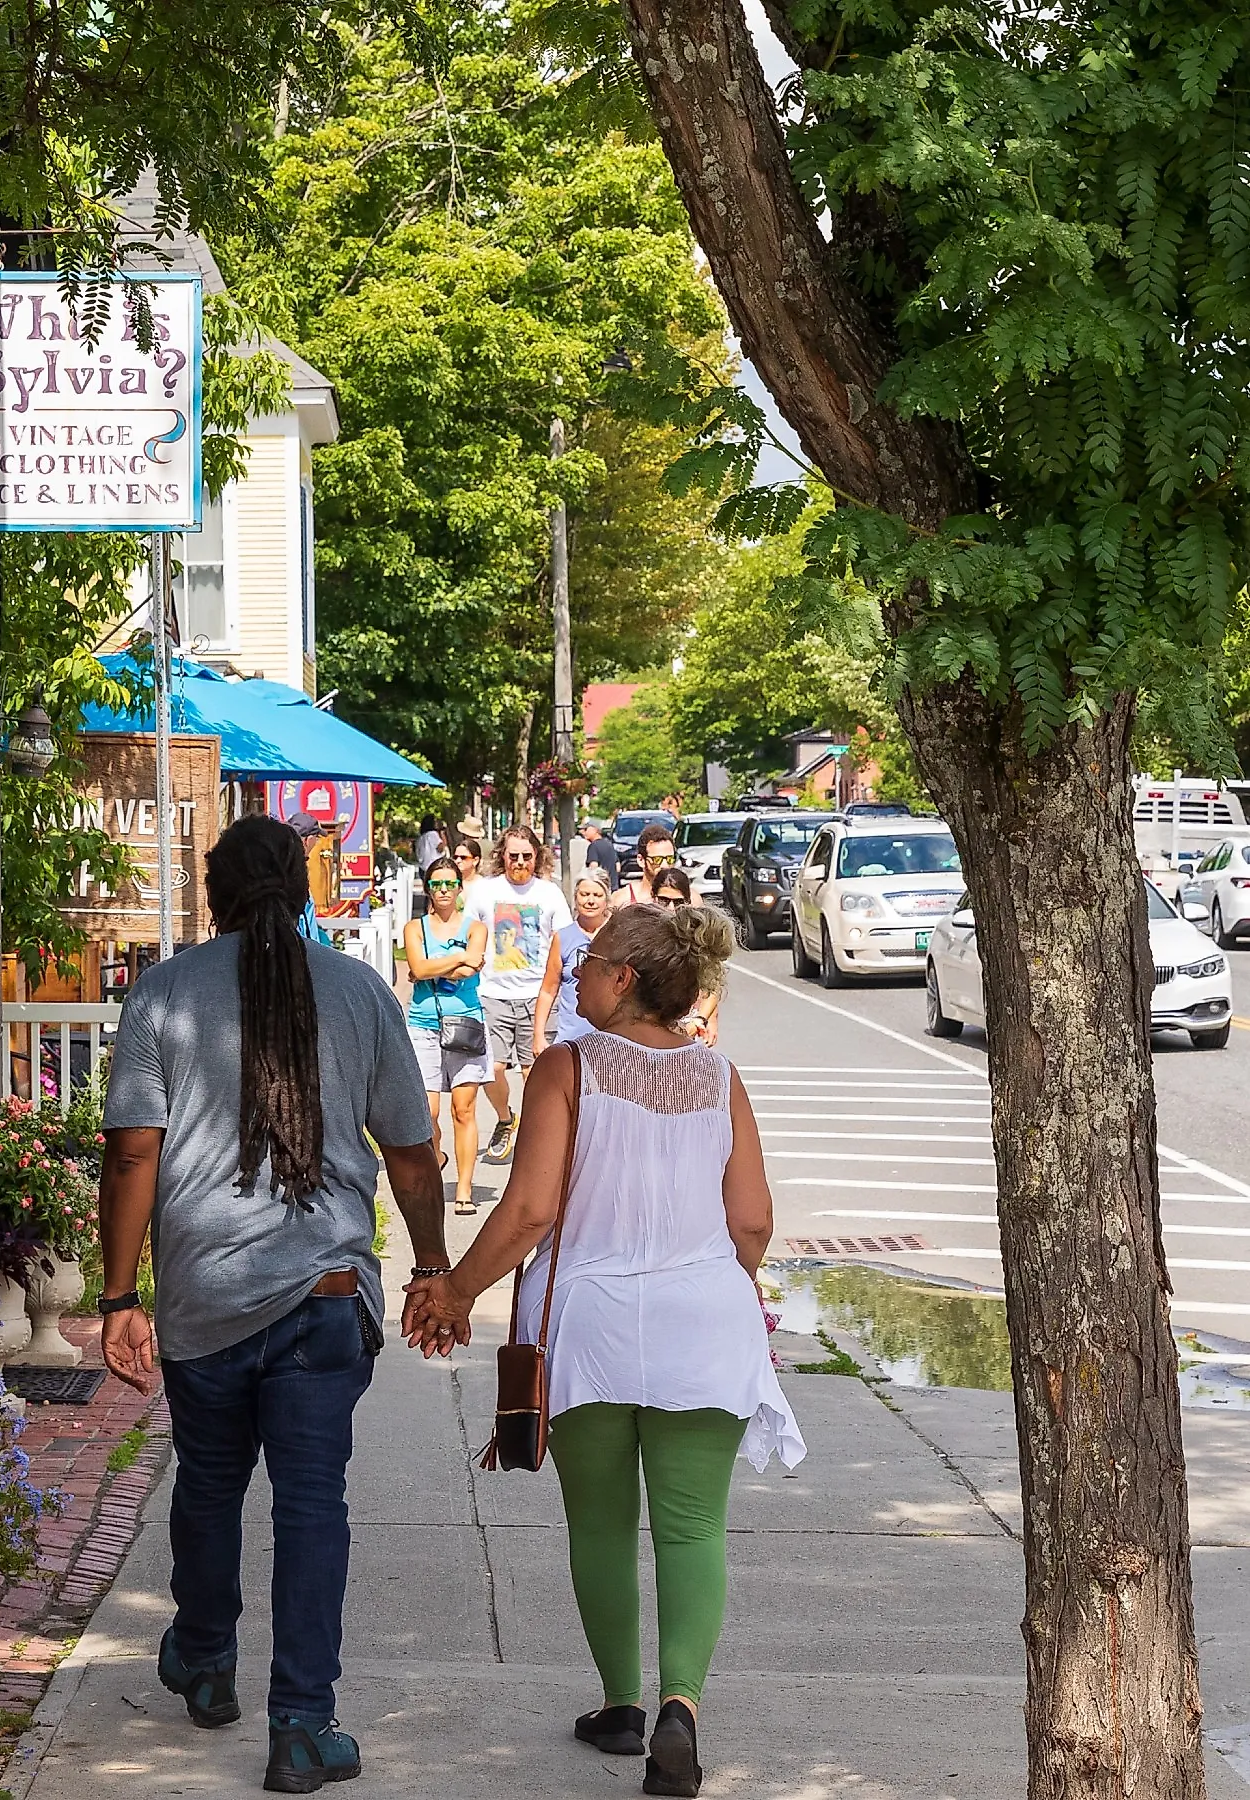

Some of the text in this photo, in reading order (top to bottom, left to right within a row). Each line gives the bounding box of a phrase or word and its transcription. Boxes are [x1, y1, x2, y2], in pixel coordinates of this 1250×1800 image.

[8, 425, 133, 446] VINTAGE
[0, 454, 147, 474] CLOTHING
[37, 484, 59, 504] &
[67, 484, 179, 504] LINENS
